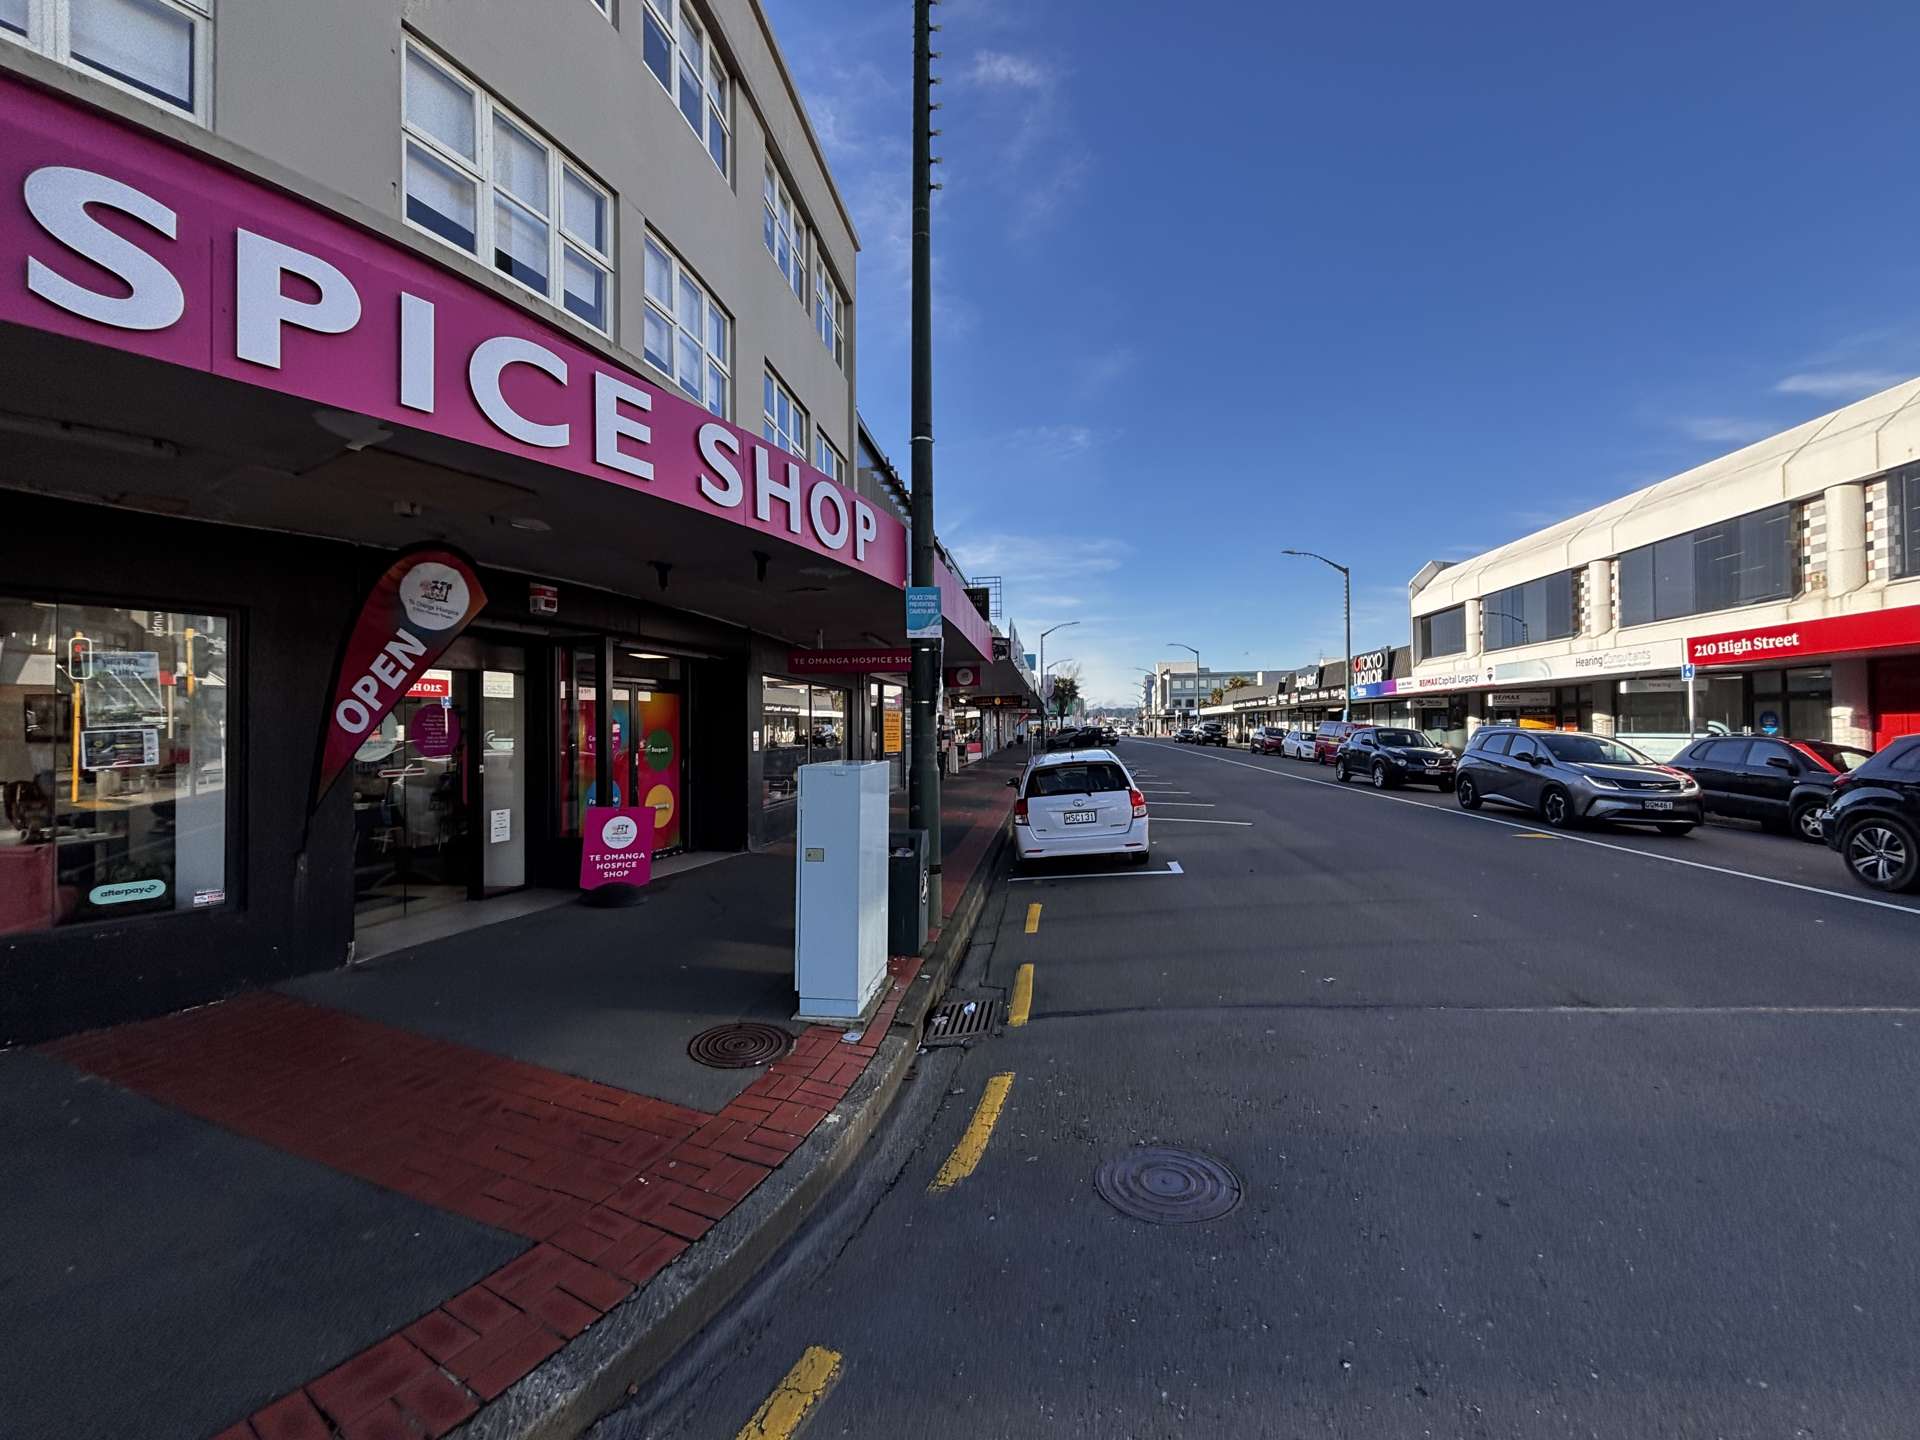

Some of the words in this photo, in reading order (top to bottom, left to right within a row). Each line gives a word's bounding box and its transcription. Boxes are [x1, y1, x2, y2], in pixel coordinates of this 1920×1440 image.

[24, 166, 655, 480] SPICE
[698, 422, 877, 562] SHOP
[1694, 643, 1717, 657] 210
[1718, 638, 1752, 655] High
[1753, 633, 1800, 650] Street
[793, 657, 805, 665] TE
[808, 656, 849, 665] OMANGA
[851, 655, 893, 664] HOSPICE
[894, 655, 912, 664] SHO
[1360, 652, 1383, 669] TOKYO
[1576, 655, 1603, 668] Hearing
[335, 627, 428, 735] OPEN
[1353, 669, 1383, 687] LIQUOR
[1439, 675, 1457, 687] Capital
[1457, 673, 1479, 684] Legacy
[589, 854, 601, 862] TE
[604, 852, 645, 862] OMANGA
[596, 861, 638, 870] HOSPICE
[603, 870, 629, 878] SHOP
[99, 886, 145, 898] afterpay
